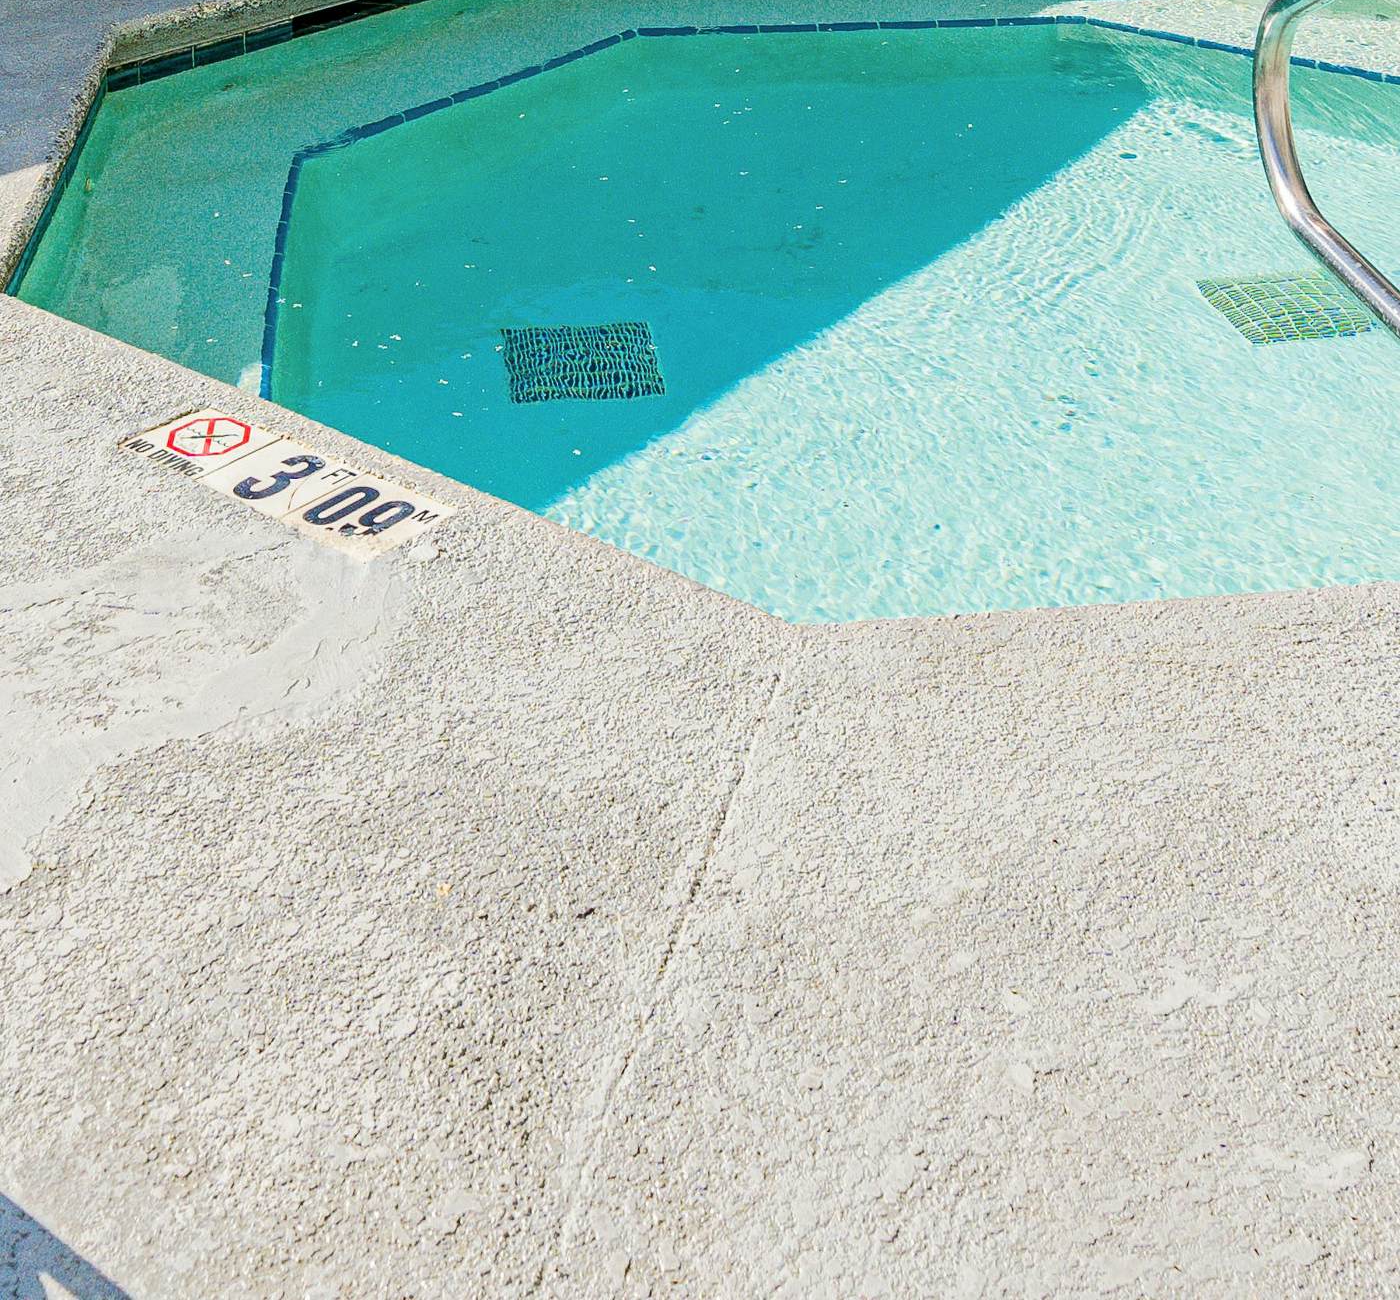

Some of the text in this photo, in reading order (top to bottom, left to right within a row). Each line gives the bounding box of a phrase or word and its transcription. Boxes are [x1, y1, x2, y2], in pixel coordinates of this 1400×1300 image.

[126, 438, 205, 477] NO DIVING
[232, 454, 357, 500] 3 FT
[411, 509, 439, 524] M
